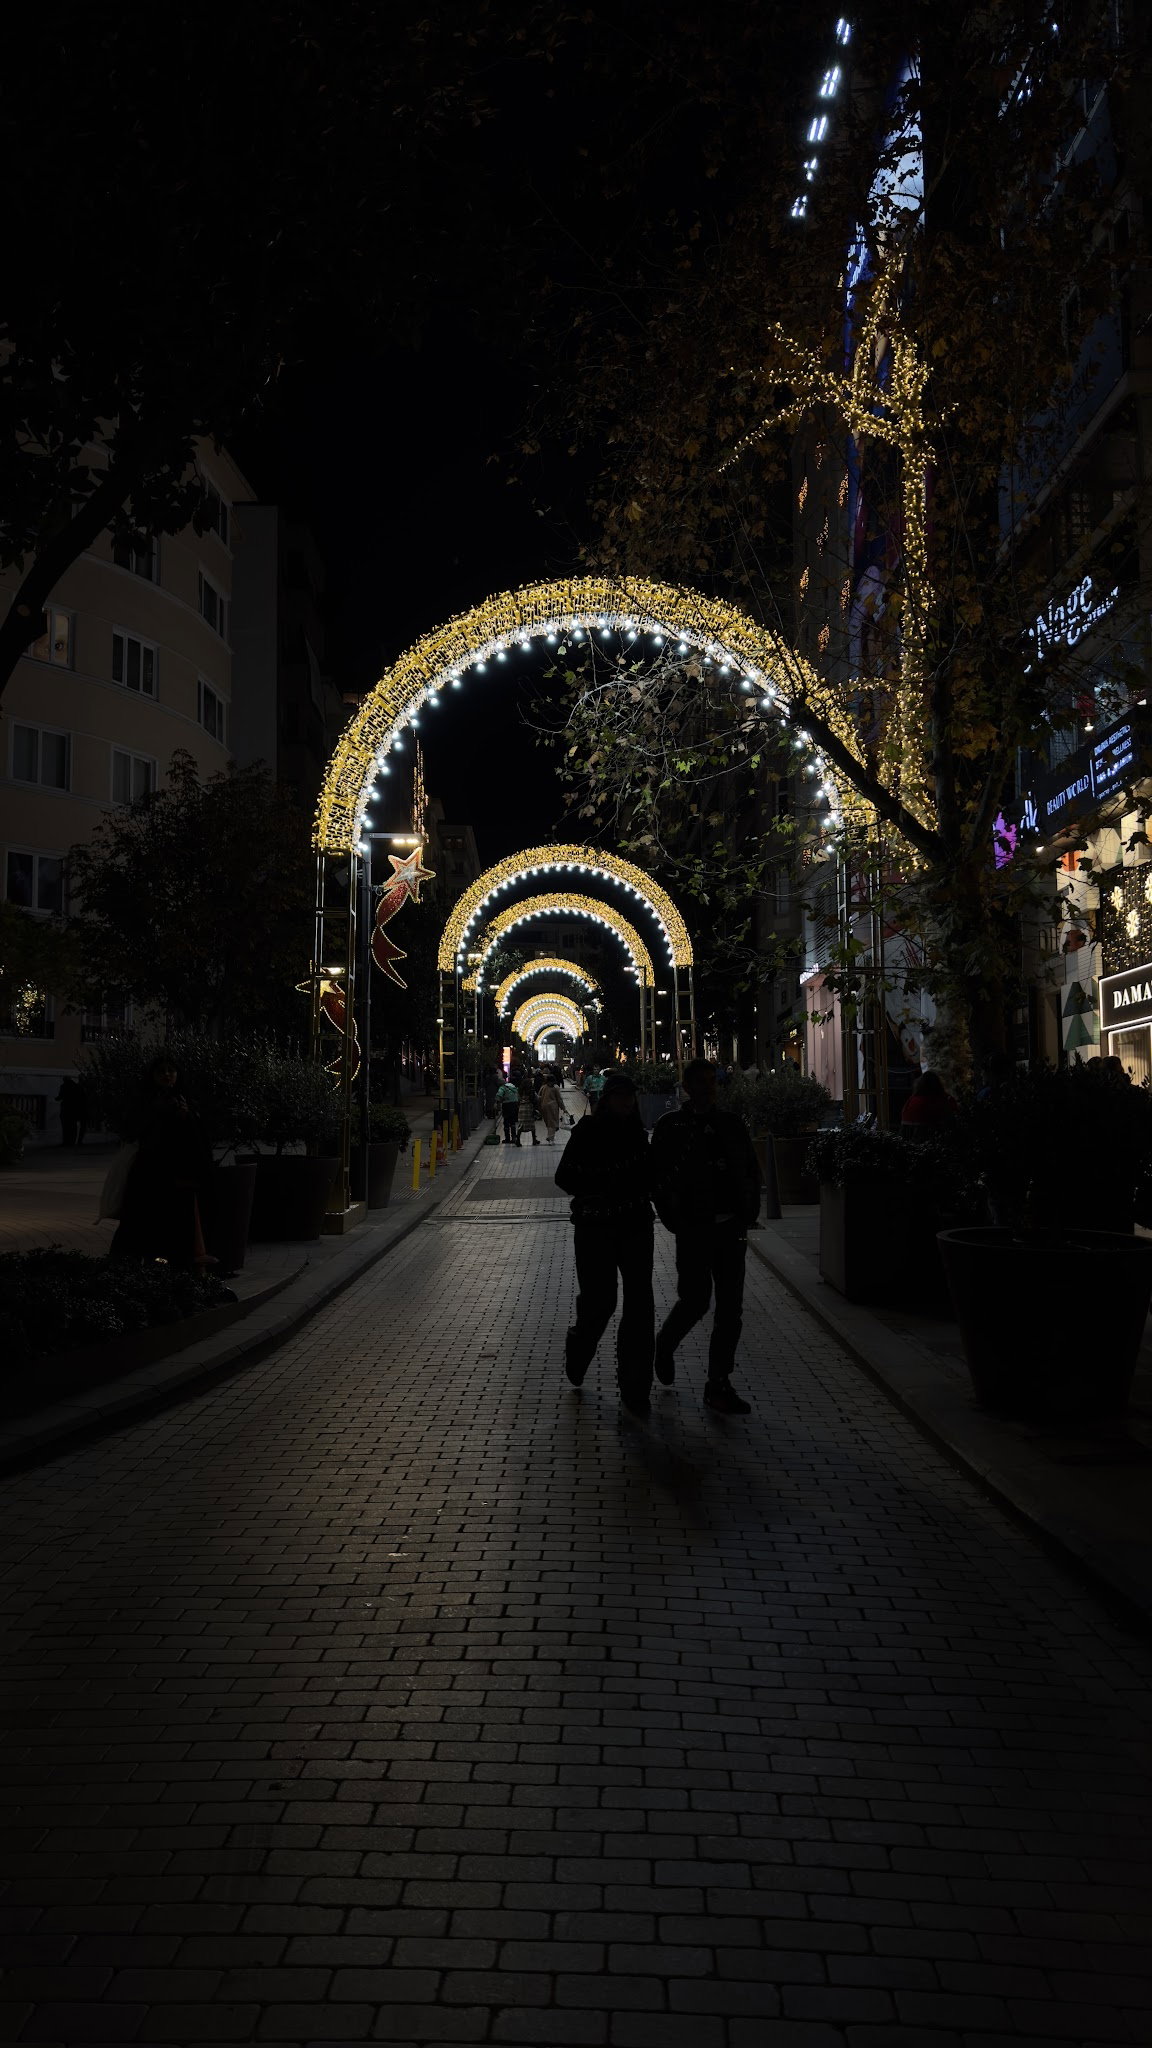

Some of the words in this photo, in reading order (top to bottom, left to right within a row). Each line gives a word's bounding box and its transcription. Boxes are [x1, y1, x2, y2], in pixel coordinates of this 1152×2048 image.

[1046, 790, 1066, 816] BEAUTY
[1066, 774, 1090, 801] WORLD
[1112, 979, 1152, 1009] DAMA
